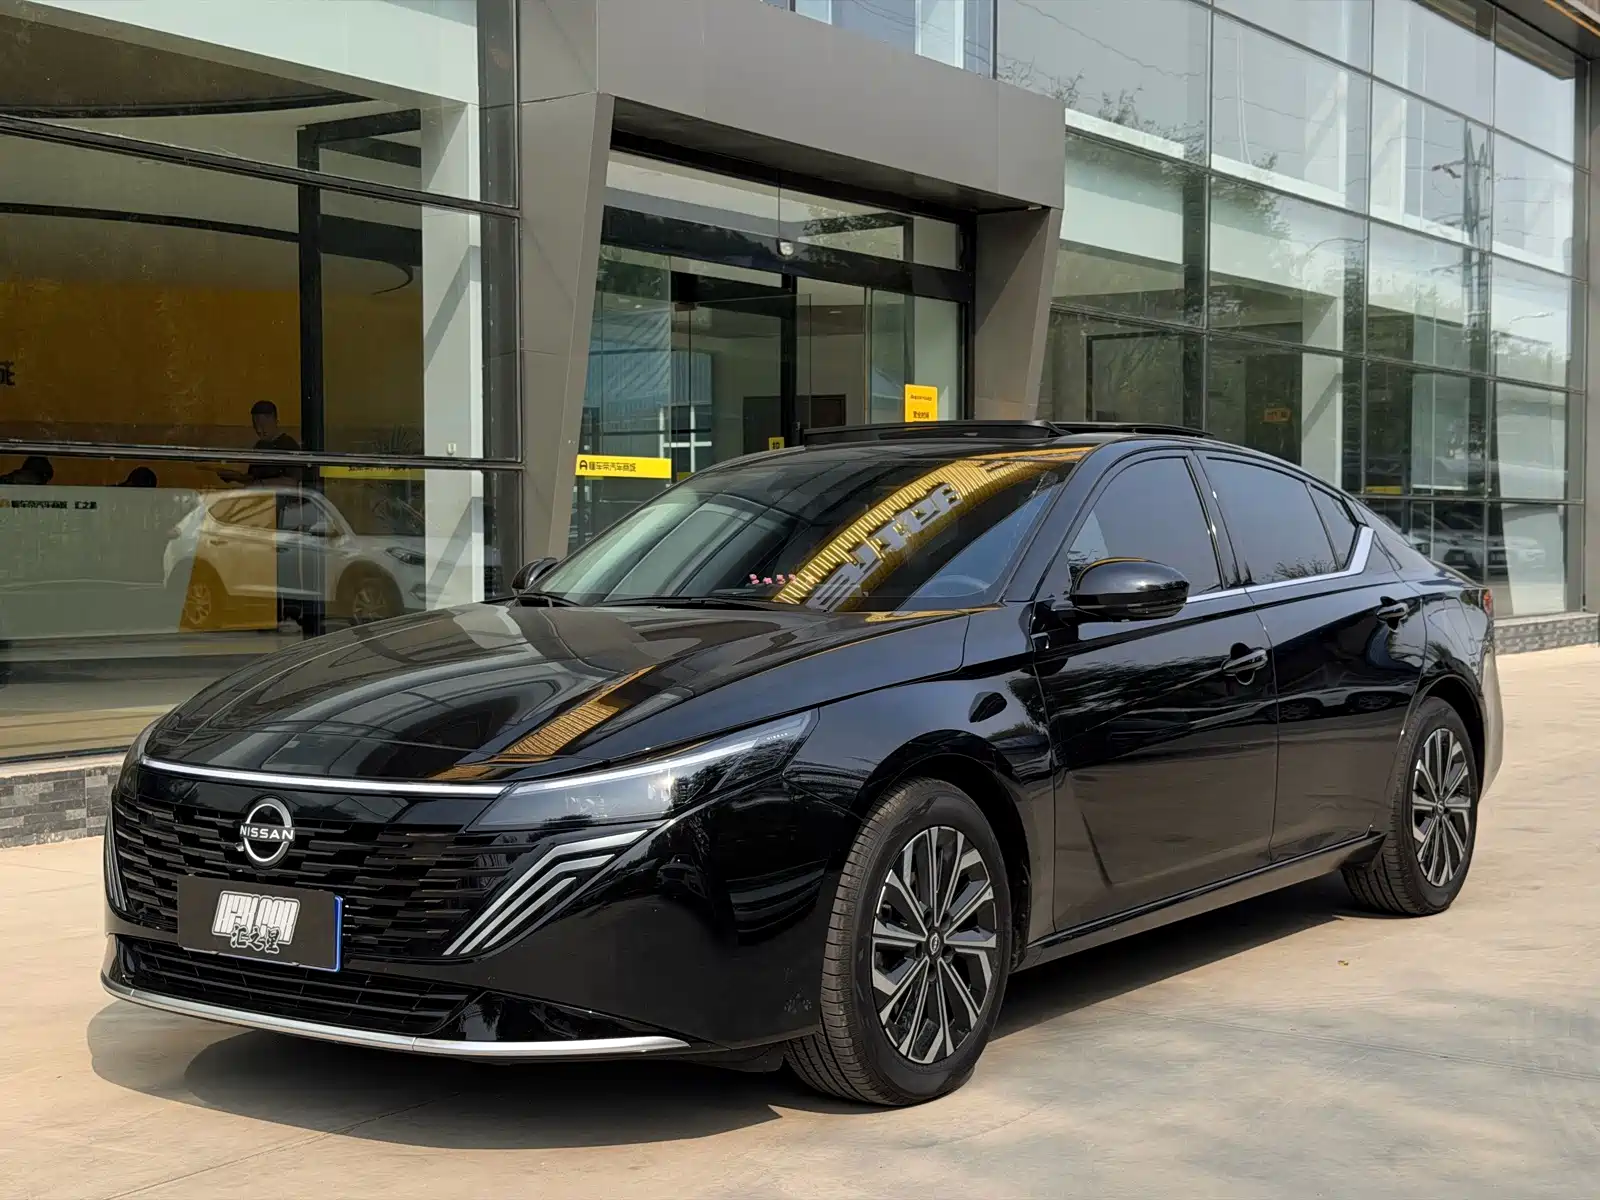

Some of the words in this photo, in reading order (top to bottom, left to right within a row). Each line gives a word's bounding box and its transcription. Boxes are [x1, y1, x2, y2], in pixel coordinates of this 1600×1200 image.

[240, 825, 294, 840] NISSAN
[230, 924, 280, 955] 汇之星
